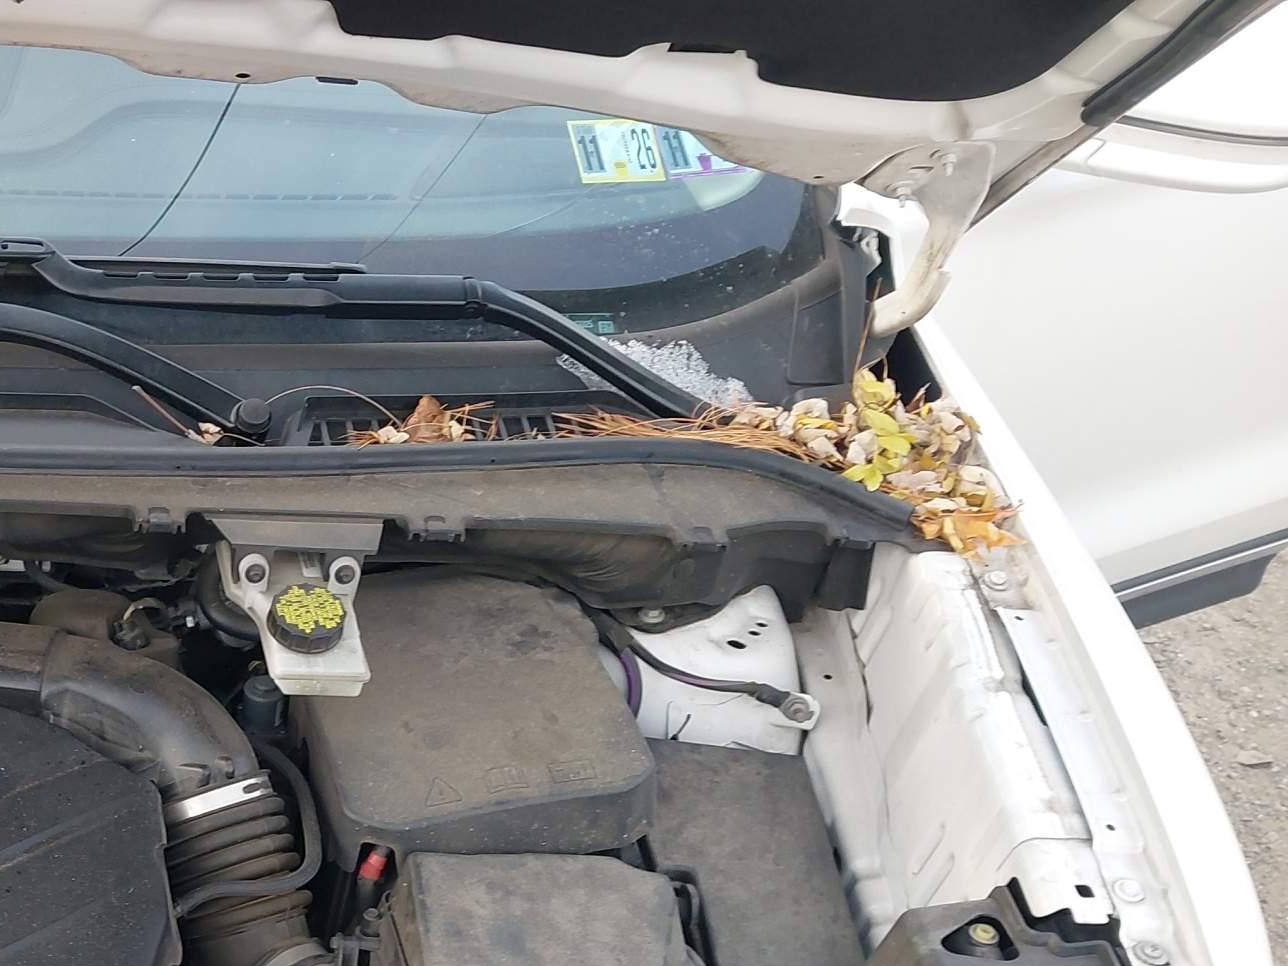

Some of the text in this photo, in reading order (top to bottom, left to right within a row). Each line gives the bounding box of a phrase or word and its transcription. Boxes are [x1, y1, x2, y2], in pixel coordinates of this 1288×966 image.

[578, 135, 605, 171] 11
[630, 128, 657, 170] 26
[662, 130, 691, 168] 11
